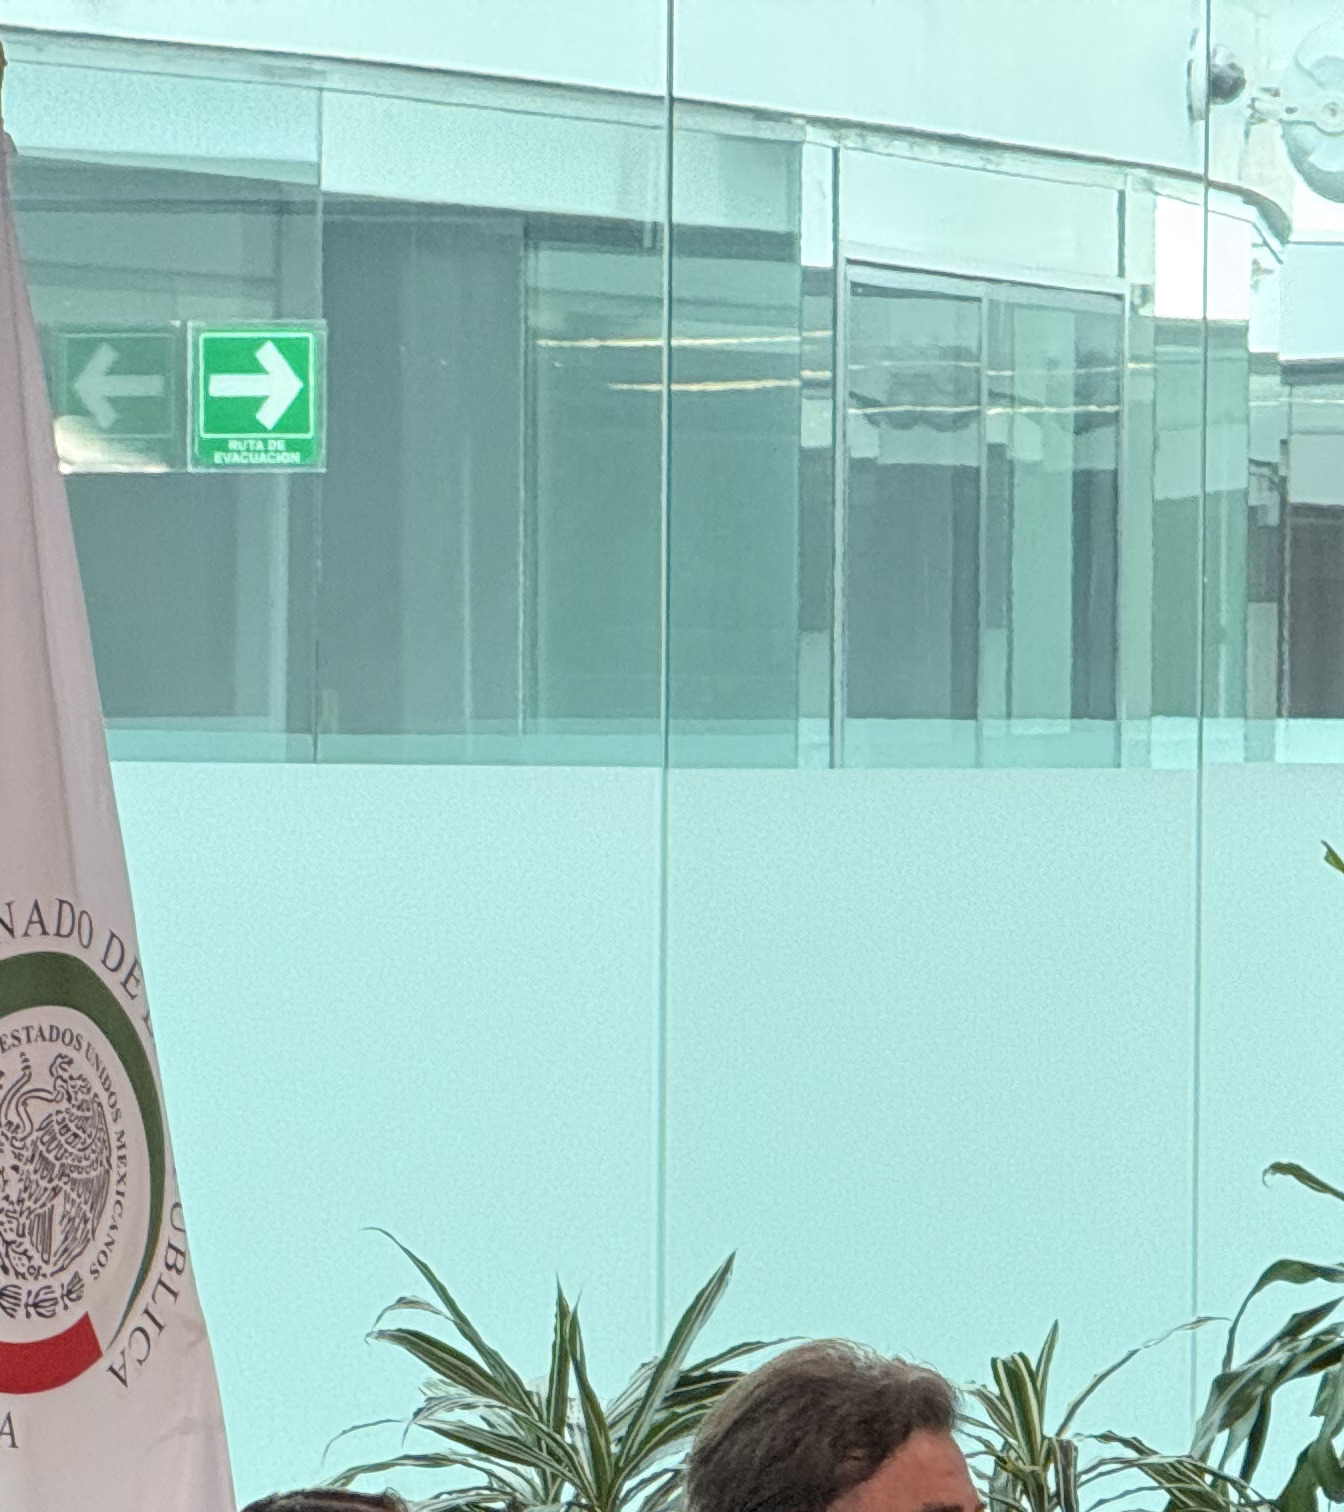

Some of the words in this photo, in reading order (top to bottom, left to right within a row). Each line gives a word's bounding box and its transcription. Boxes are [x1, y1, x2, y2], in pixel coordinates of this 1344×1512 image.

[228, 439, 263, 451] RUTA
[268, 439, 286, 451] DE
[85, 1042, 122, 1124] UNIDOS
[89, 1128, 127, 1281] MEXICANOS
